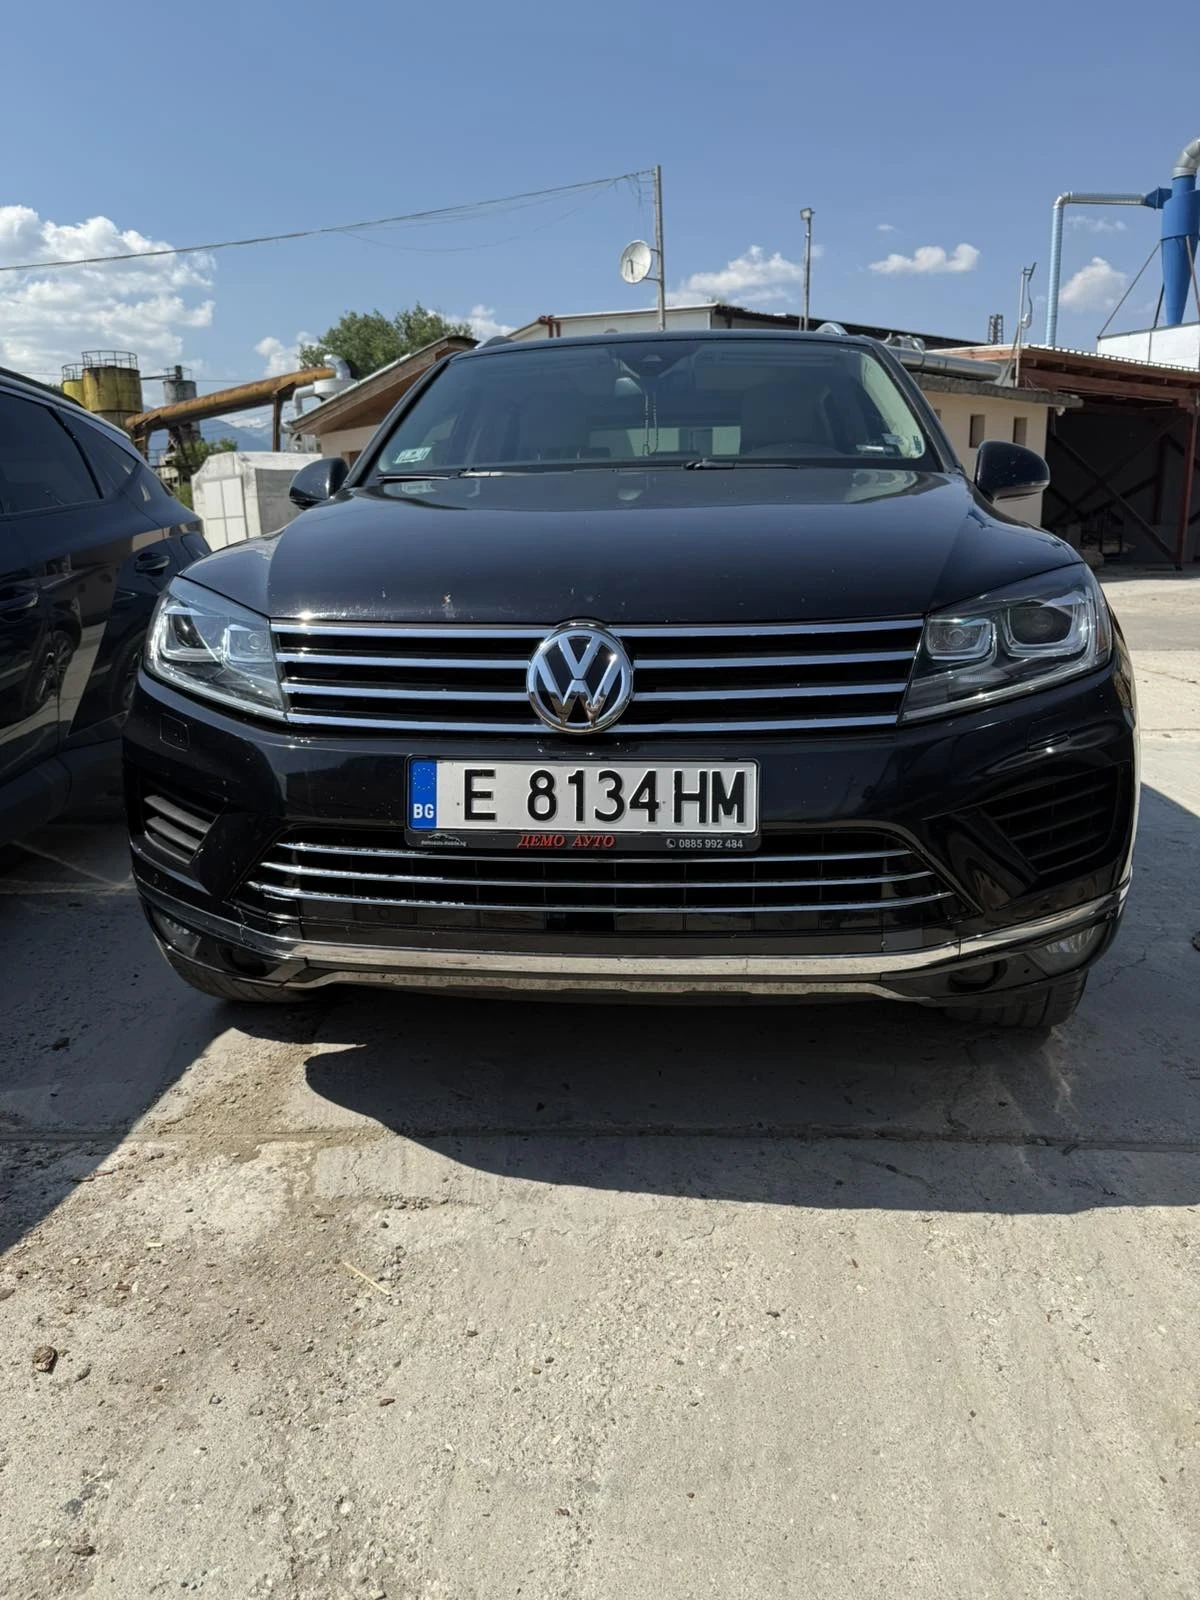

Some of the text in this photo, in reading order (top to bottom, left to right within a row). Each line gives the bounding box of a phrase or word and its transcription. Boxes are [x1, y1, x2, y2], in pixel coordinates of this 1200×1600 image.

[464, 769, 745, 824] E 8134 HM
[413, 804, 435, 819] BG
[517, 834, 565, 848] ДЕМО
[678, 839, 743, 849] 0885 992 484
